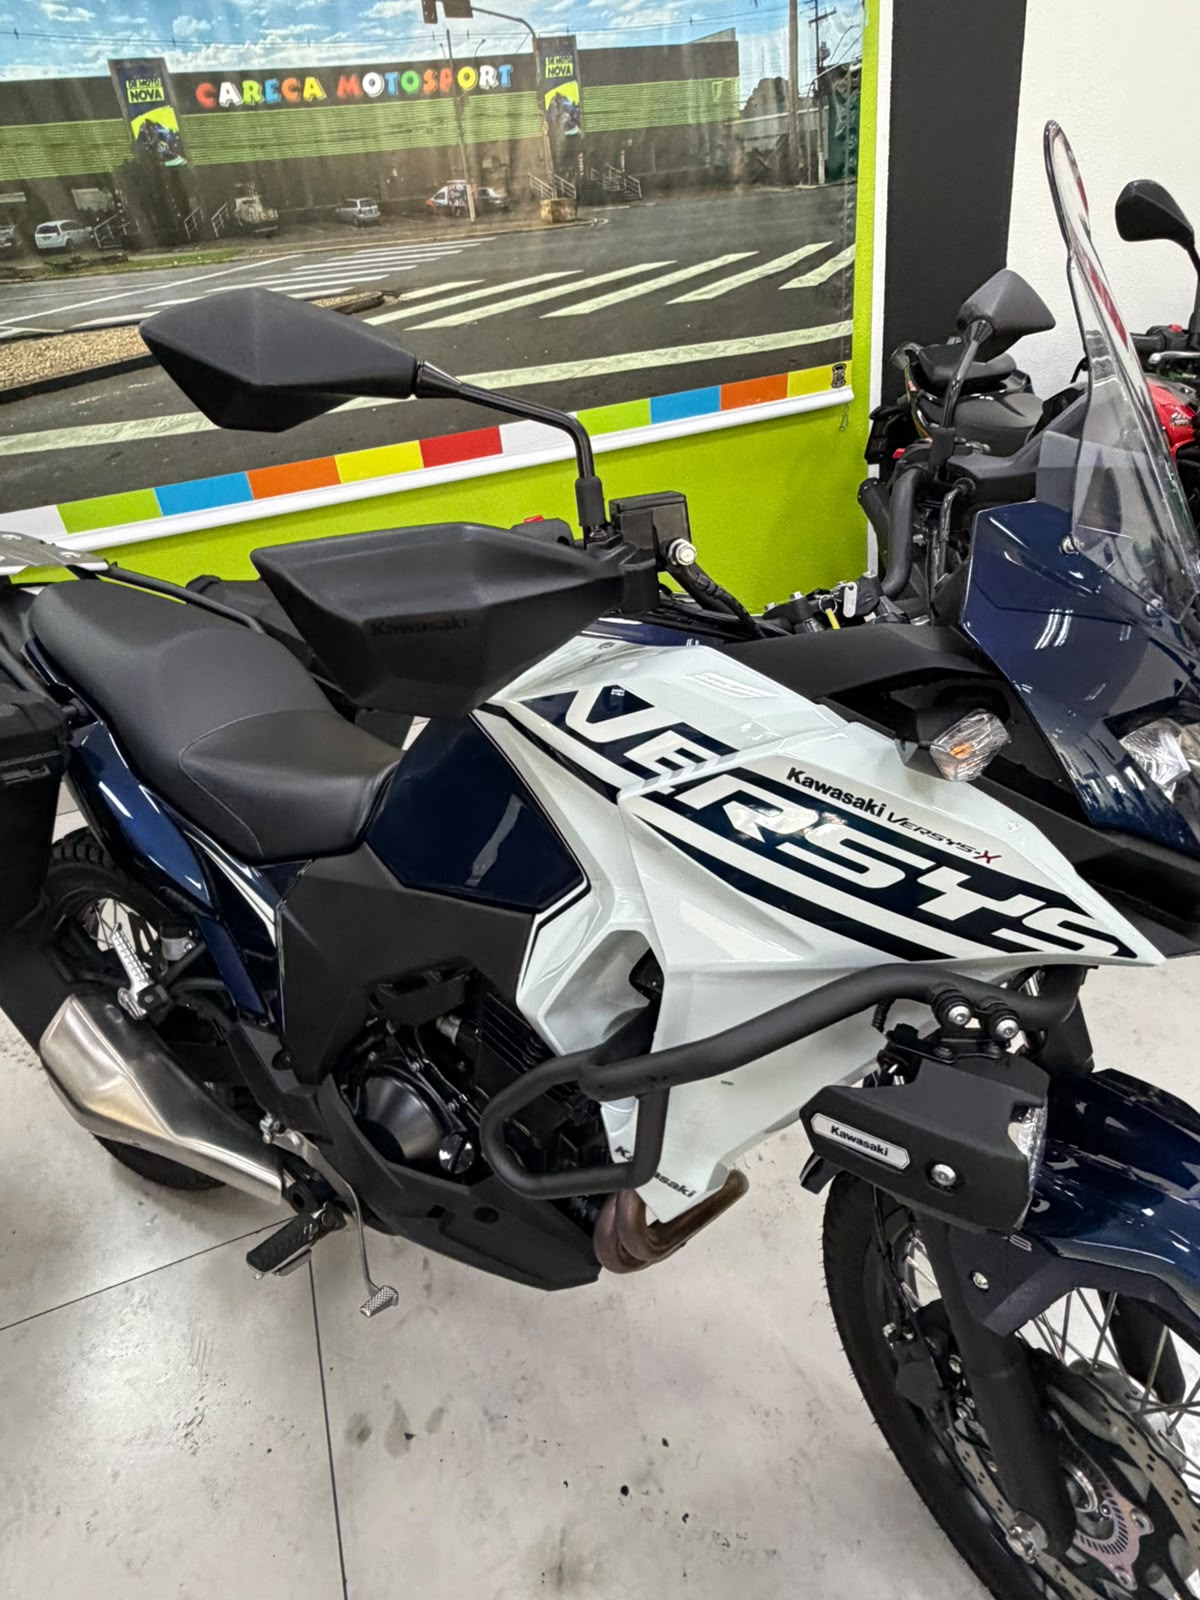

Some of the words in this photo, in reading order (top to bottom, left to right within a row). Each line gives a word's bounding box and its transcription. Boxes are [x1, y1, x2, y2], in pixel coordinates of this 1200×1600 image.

[194, 76, 327, 108] CARECA
[336, 64, 513, 99] MOTOSPORT
[547, 65, 572, 77] NOVA
[129, 88, 163, 102] NOVA
[565, 684, 1120, 957] VERSYS
[786, 766, 887, 818] Kawasaki
[887, 811, 1003, 865] VERSYS-X
[830, 1125, 889, 1157] Kawasaki
